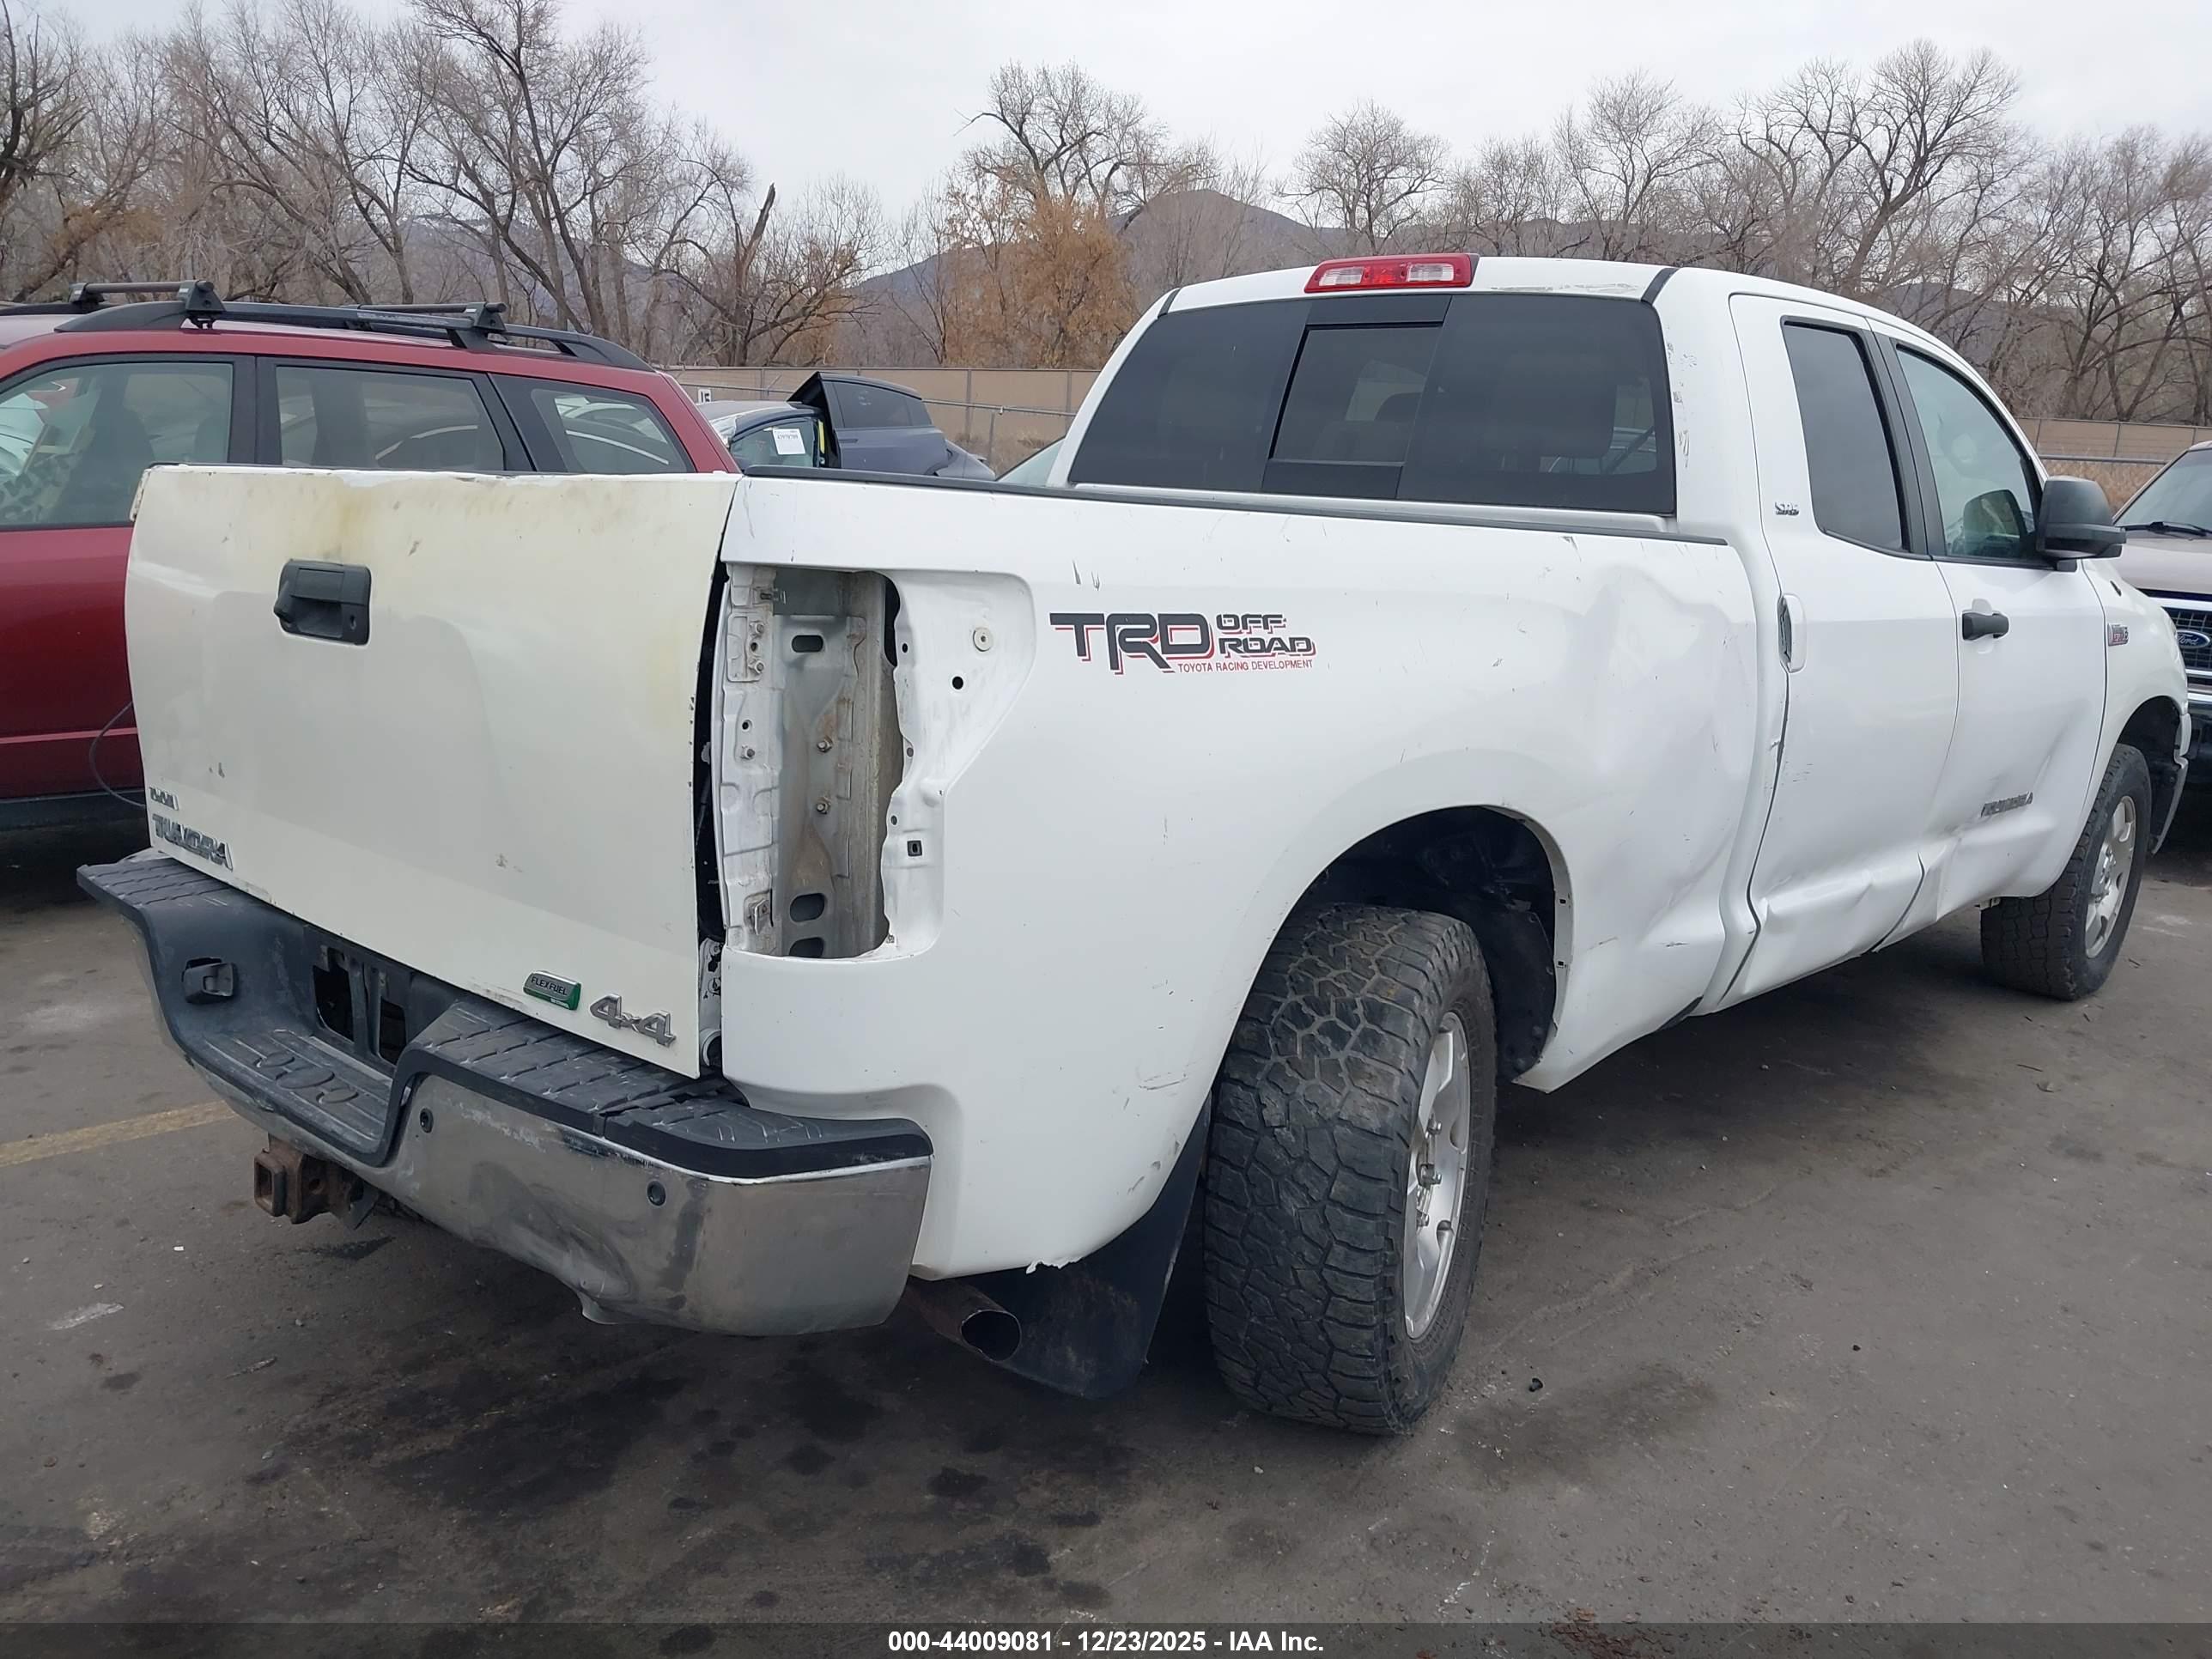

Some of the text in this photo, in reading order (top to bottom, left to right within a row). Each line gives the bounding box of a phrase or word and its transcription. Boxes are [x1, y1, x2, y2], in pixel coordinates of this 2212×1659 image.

[1216, 613, 1286, 634] OFF
[1049, 612, 1214, 674] TRD
[1218, 636, 1316, 658] ROAD
[1178, 659, 1313, 672] TOYOTA RACING DEVELOPMENT
[531, 975, 568, 996] FLEX FUEL
